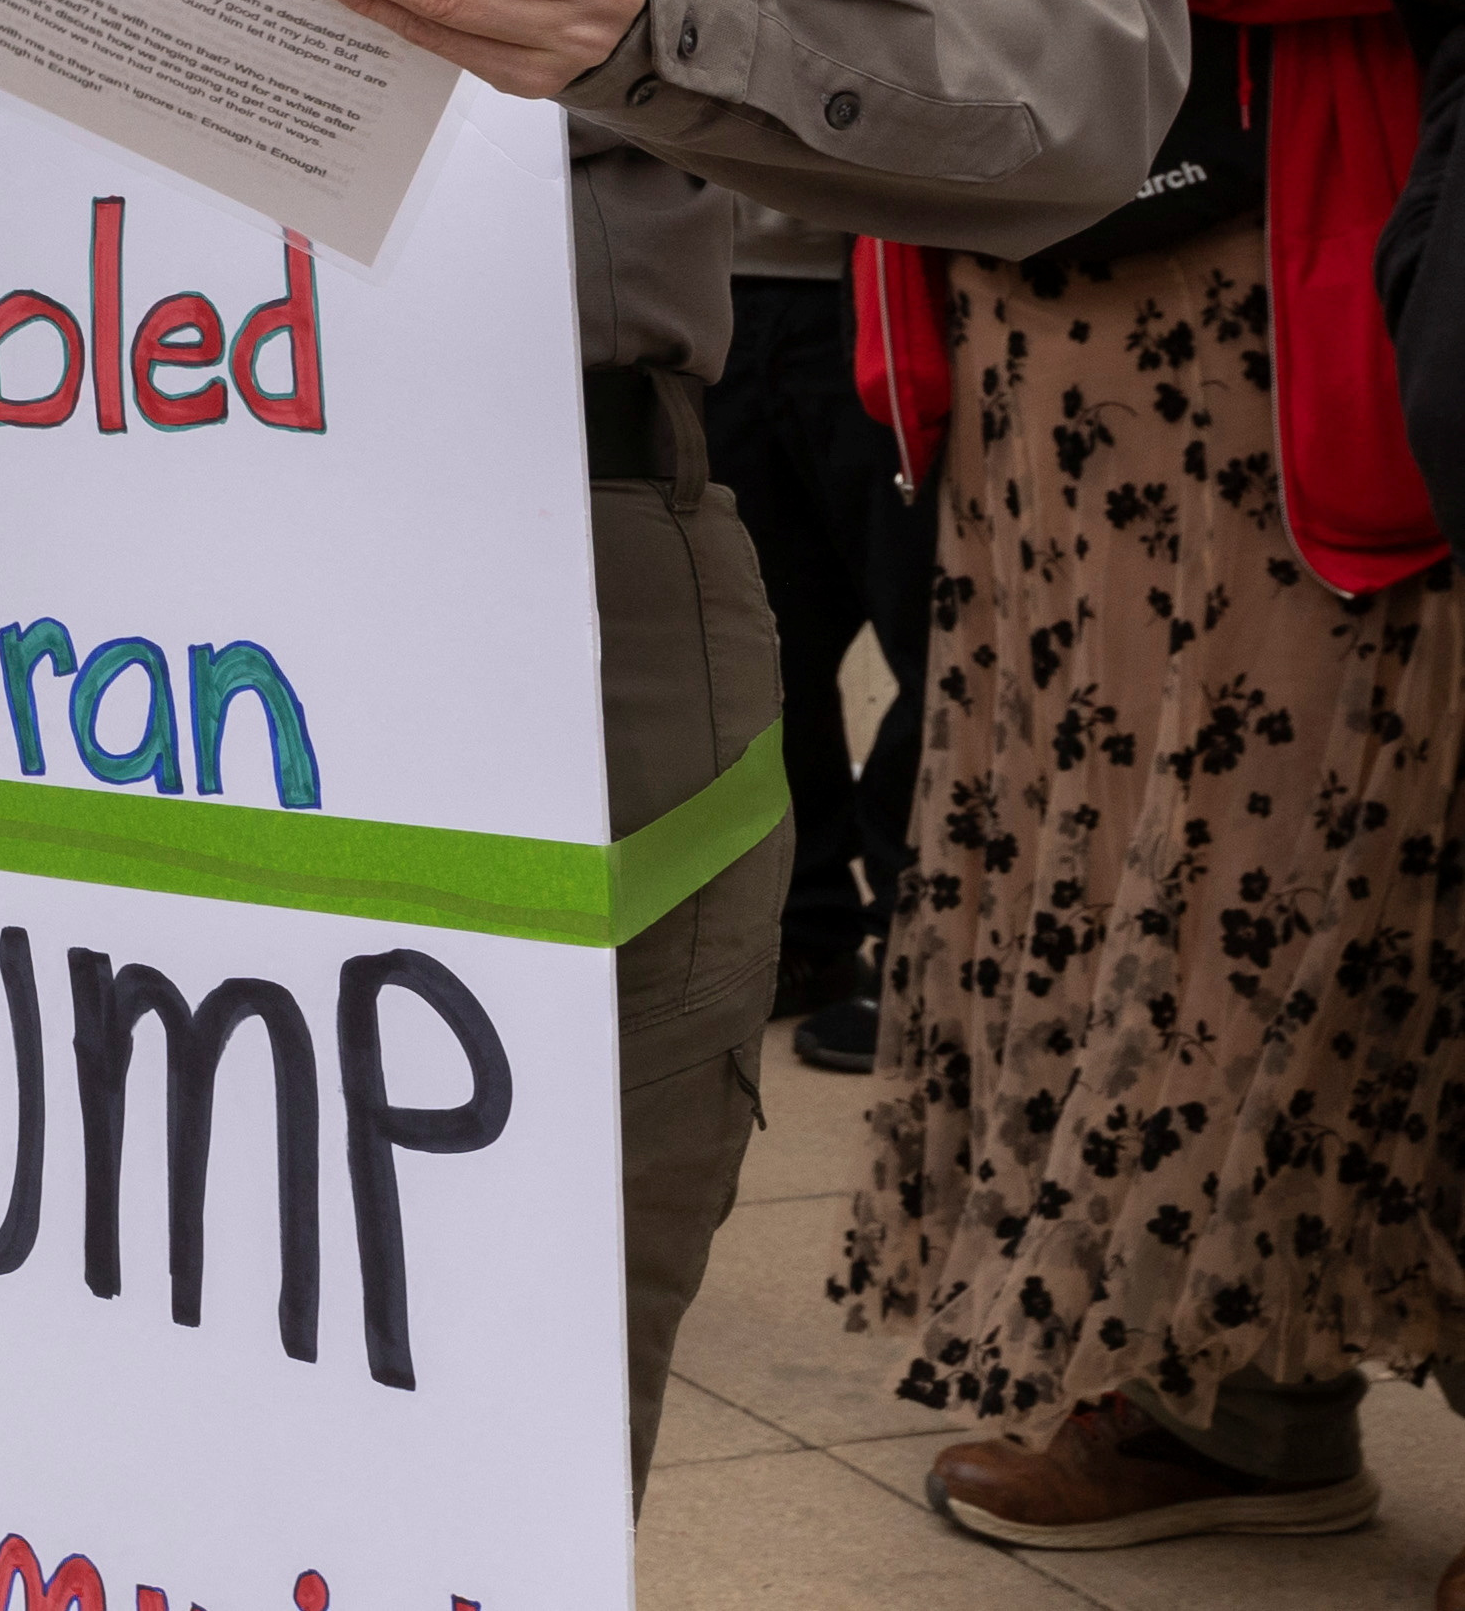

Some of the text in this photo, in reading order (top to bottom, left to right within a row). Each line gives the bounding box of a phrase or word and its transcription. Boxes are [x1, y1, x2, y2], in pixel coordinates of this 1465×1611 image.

[24, 37, 45, 52] me
[47, 48, 64, 61] so
[66, 56, 95, 76] they
[97, 72, 130, 92] can't
[132, 87, 174, 110] ignore
[176, 106, 197, 120] us:
[200, 116, 252, 145] Enough
[254, 139, 267, 151] is
[269, 146, 327, 177] Enough!
[32, 11, 67, 34] know
[69, 31, 89, 45] we
[91, 40, 124, 61] have
[126, 56, 153, 74] had
[155, 71, 205, 97] enough
[208, 94, 224, 104] of
[224, 100, 255, 118] their
[258, 115, 283, 129] evil
[285, 126, 326, 149] ways.
[33, 54, 45, 66] is
[47, 61, 102, 92] Enough!
[54, 9, 103, 37] discuss
[106, 32, 135, 51] how
[137, 48, 157, 62] we
[159, 59, 182, 73] are
[184, 70, 222, 92] going
[224, 86, 239, 98] to
[241, 94, 265, 109] get
[266, 105, 290, 119] our
[293, 115, 336, 139] voices
[99, 16, 122, 31] will
[123, 26, 141, 41] be
[143, 36, 197, 67] hanging
[199, 63, 249, 88] around
[250, 83, 270, 96] for
[285, 98, 320, 118] while
[323, 115, 355, 132] after
[106, 3, 118, 15] is
[121, 12, 148, 29] with
[150, 26, 173, 40] me
[174, 37, 193, 50] on
[195, 45, 230, 65] that?
[233, 61, 265, 81] Who
[267, 76, 299, 95] here
[302, 92, 344, 114] wants
[346, 109, 361, 121] to
